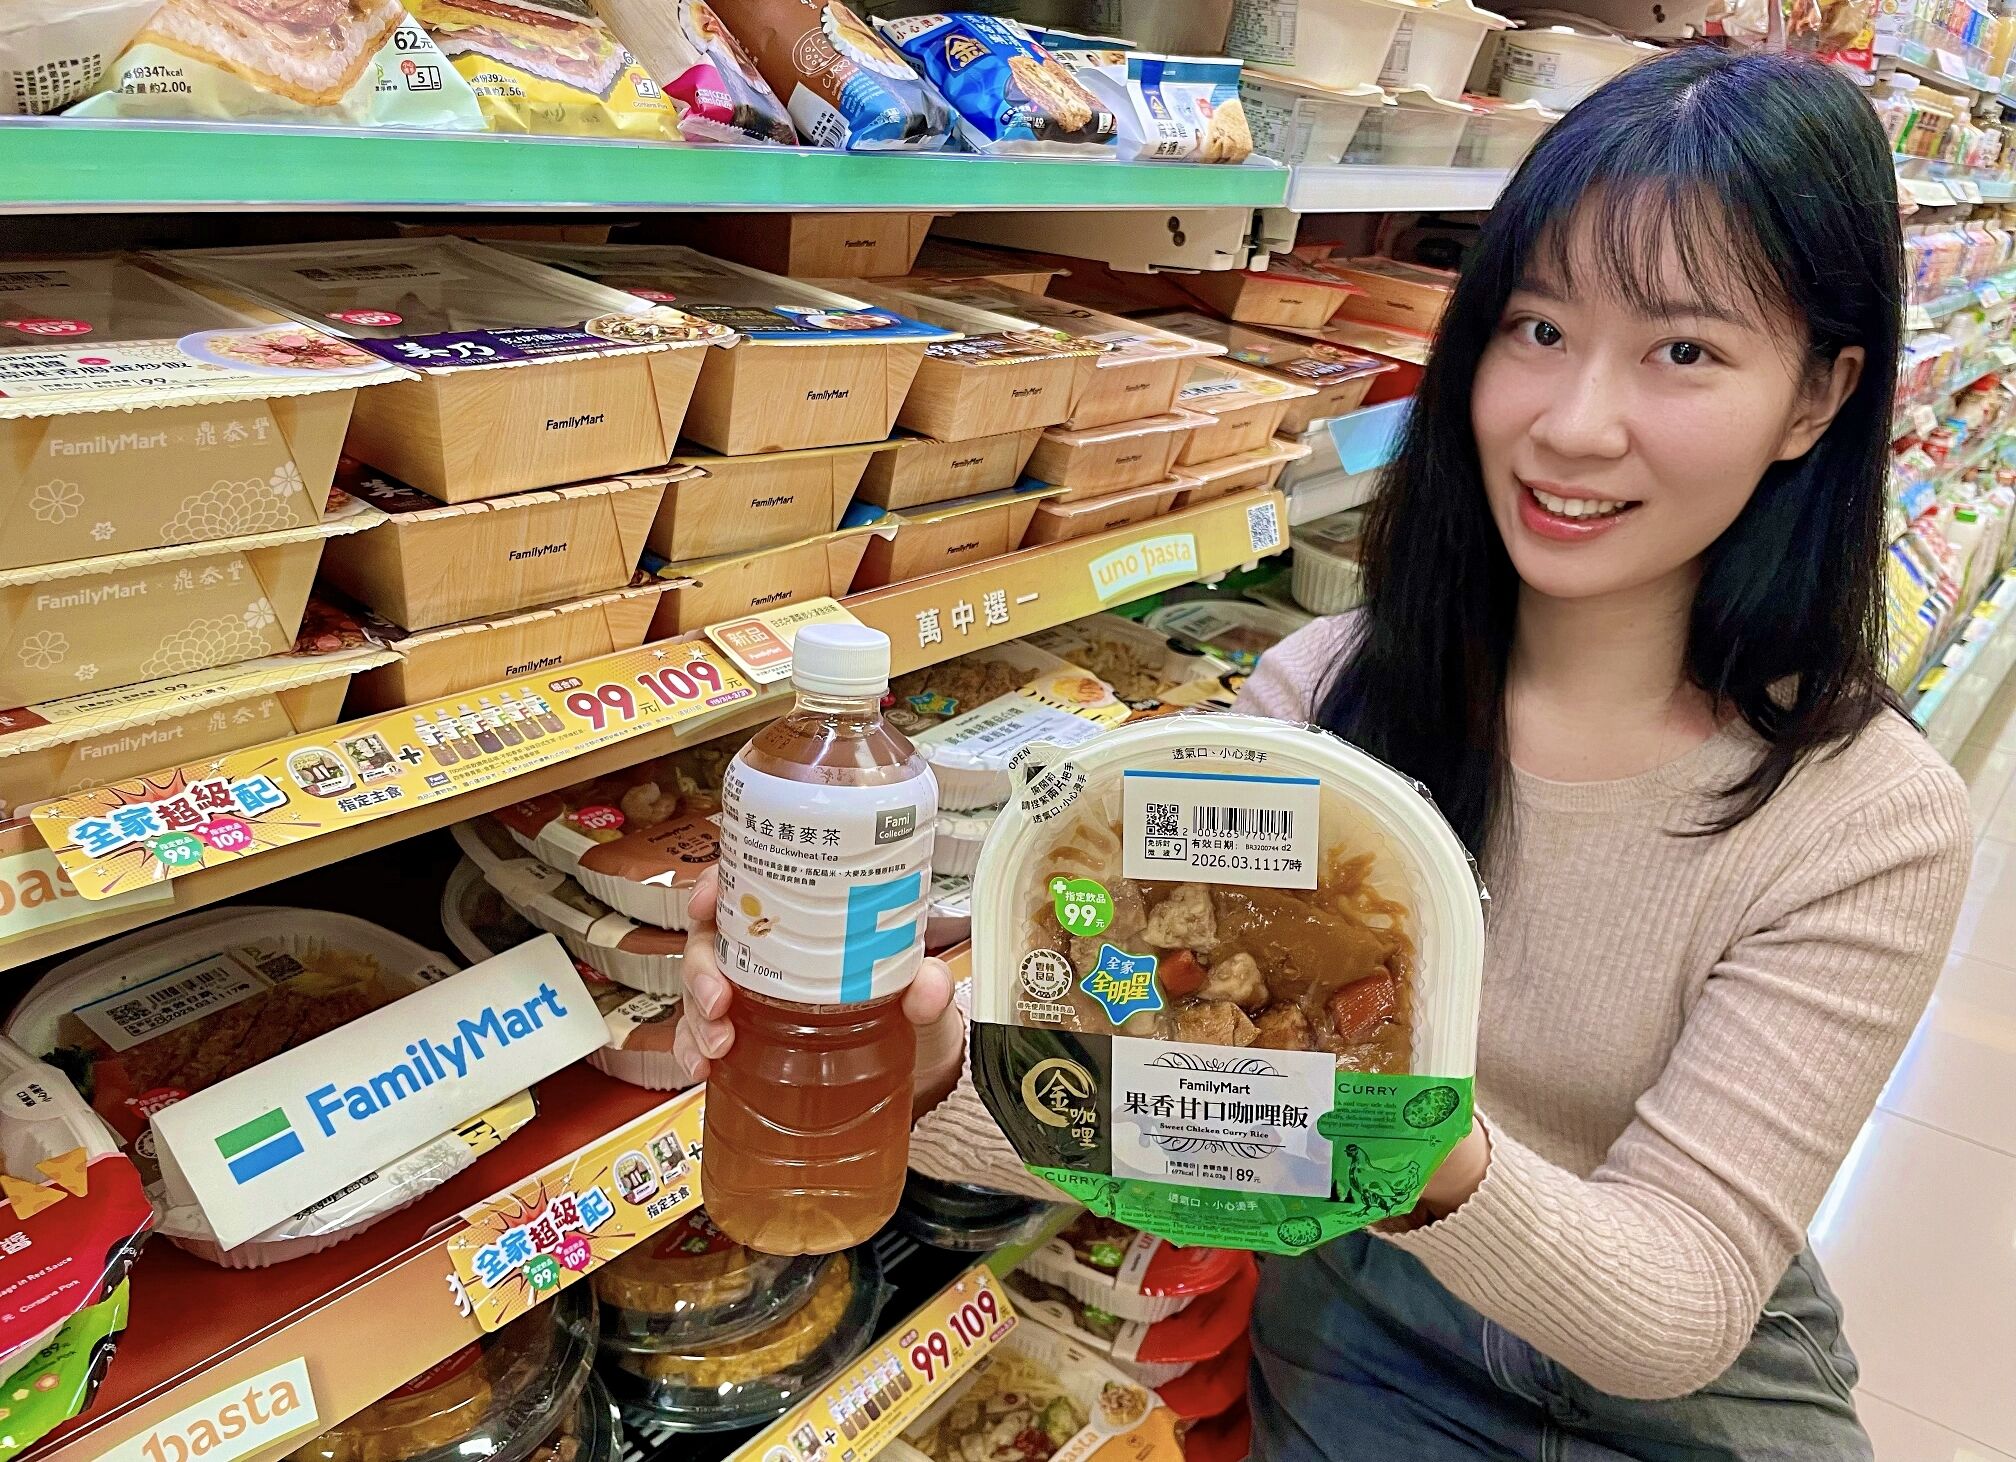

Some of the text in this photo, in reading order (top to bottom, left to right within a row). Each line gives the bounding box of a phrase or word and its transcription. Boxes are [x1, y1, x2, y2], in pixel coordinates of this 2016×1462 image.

[806, 389, 849, 401] FamilyMart
[546, 413, 604, 431] FamilyMart
[50, 432, 167, 456] FamilyMart
[751, 495, 794, 509] FamilyMart
[508, 542, 567, 561] FamilyMart
[1098, 540, 1193, 587] uno pasta
[37, 582, 147, 611] FamilyMart
[750, 590, 792, 607] FamilyMart
[915, 591, 1040, 649] 萬中選一
[726, 627, 770, 648] 新品
[505, 655, 562, 676] FamilyMart
[80, 726, 184, 761] FamilyMart
[1009, 747, 1032, 770] OPEN
[338, 786, 403, 812] 指定主食
[75, 776, 281, 852] 全家超級配
[885, 813, 910, 829] Fami
[744, 812, 841, 847] 黃金蕎麥茶
[879, 826, 913, 839] Collection
[743, 836, 840, 862] Golden Buckwheat Tea
[1173, 844, 1181, 855] 9
[1065, 891, 1106, 904] 指定飲品
[840, 871, 922, 1004] F
[753, 964, 783, 981] 700ml
[1106, 957, 1135, 975] 全家
[1092, 971, 1151, 1005] 全明星
[305, 983, 568, 1138] FamilyMart
[1036, 1070, 1089, 1112] 金
[1179, 1077, 1251, 1095] FamilyMart
[1123, 1090, 1309, 1129] 果香甘口咖哩飯
[1070, 1107, 1097, 1148] 咖哩
[1159, 1122, 1269, 1139] Sweet Chicken Curry Rice
[1044, 1170, 1099, 1186] CURRY
[646, 1187, 690, 1219] 指定主食
[476, 1190, 610, 1283] 全家超級配
[27, 1270, 46, 1281] Red
[46, 1257, 73, 1273] Sauce
